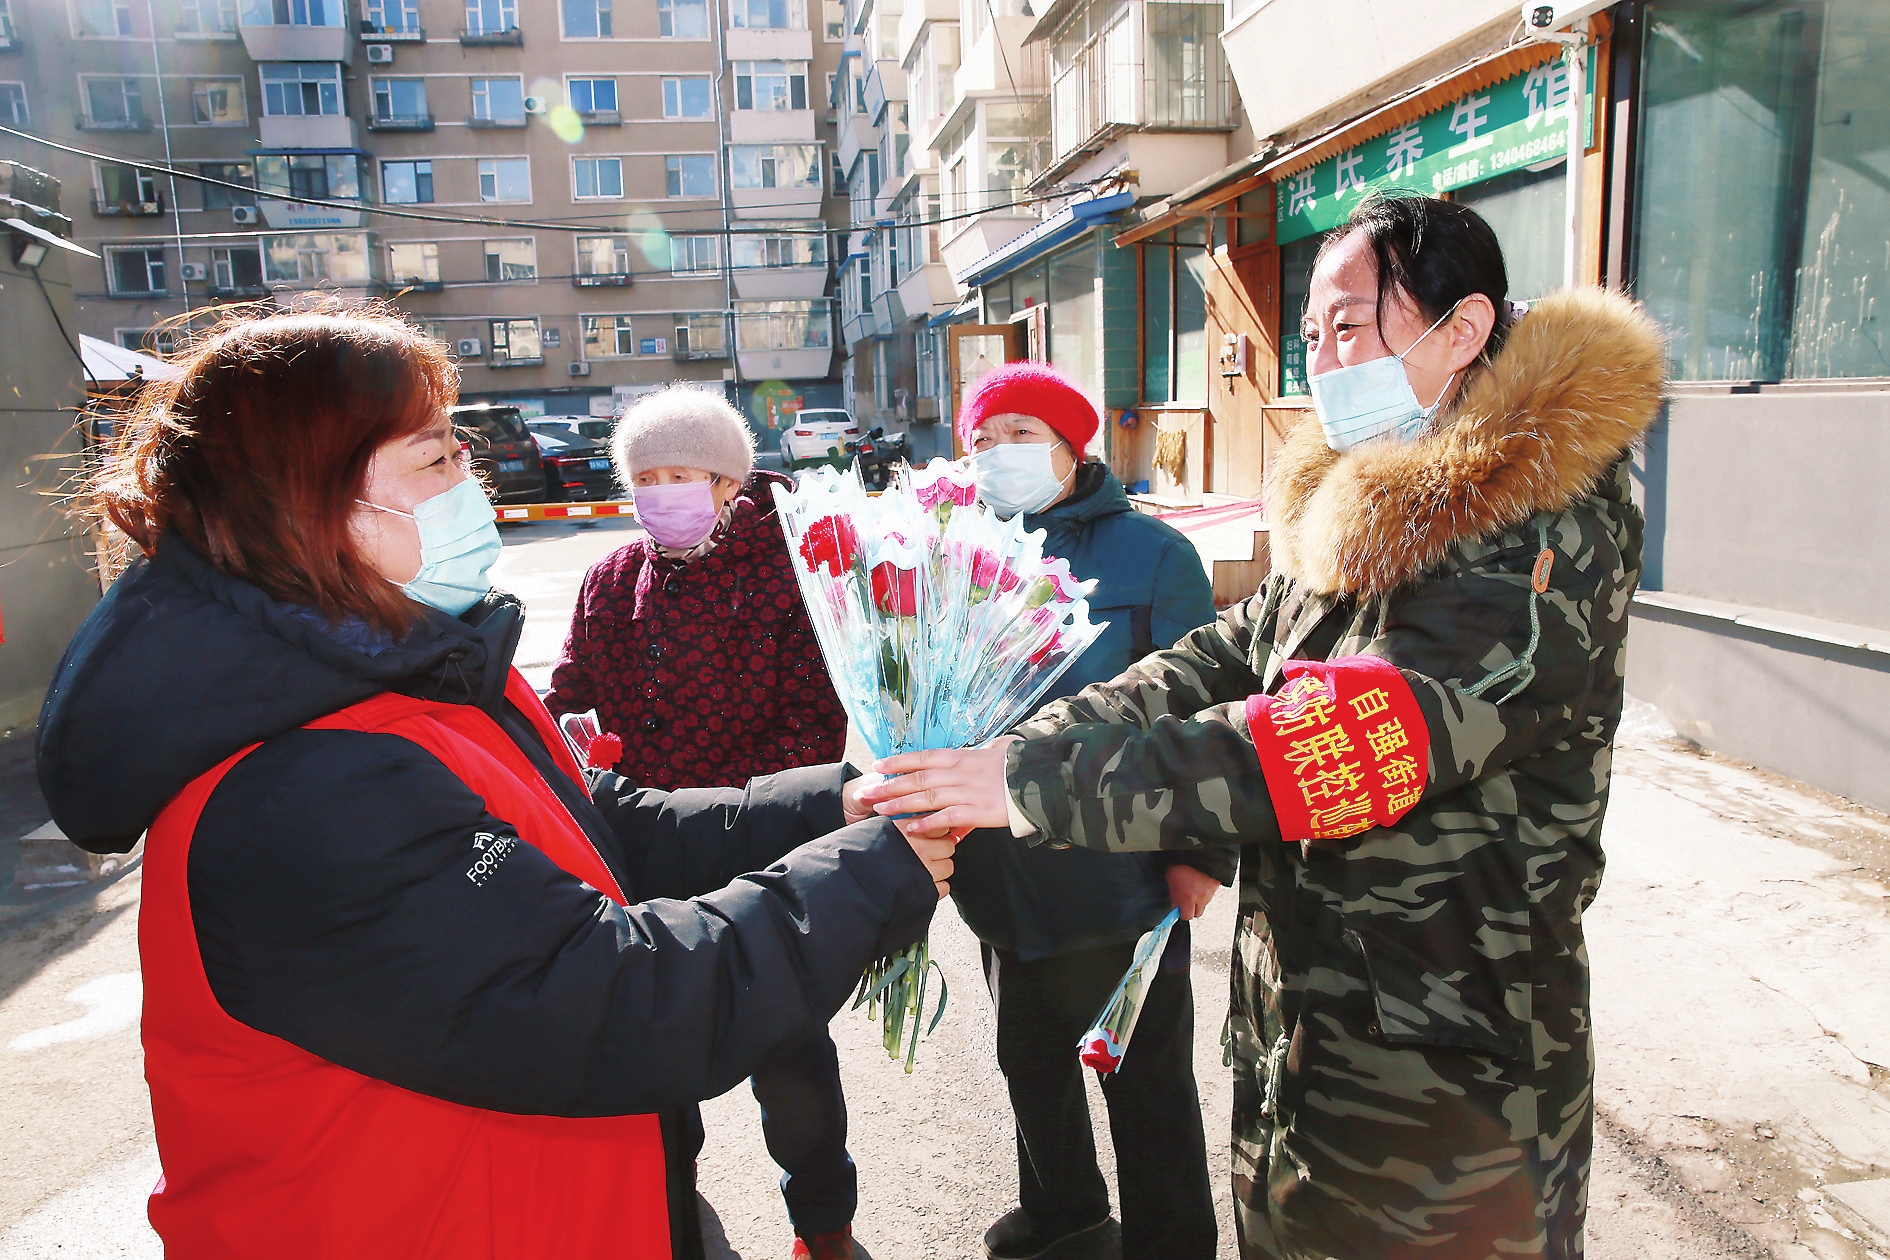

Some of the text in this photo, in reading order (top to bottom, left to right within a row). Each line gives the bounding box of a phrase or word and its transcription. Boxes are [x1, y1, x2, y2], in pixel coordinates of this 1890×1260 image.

[1288, 58, 1569, 217] 洪氏养生馆
[1348, 687, 1423, 815] 自强街道
